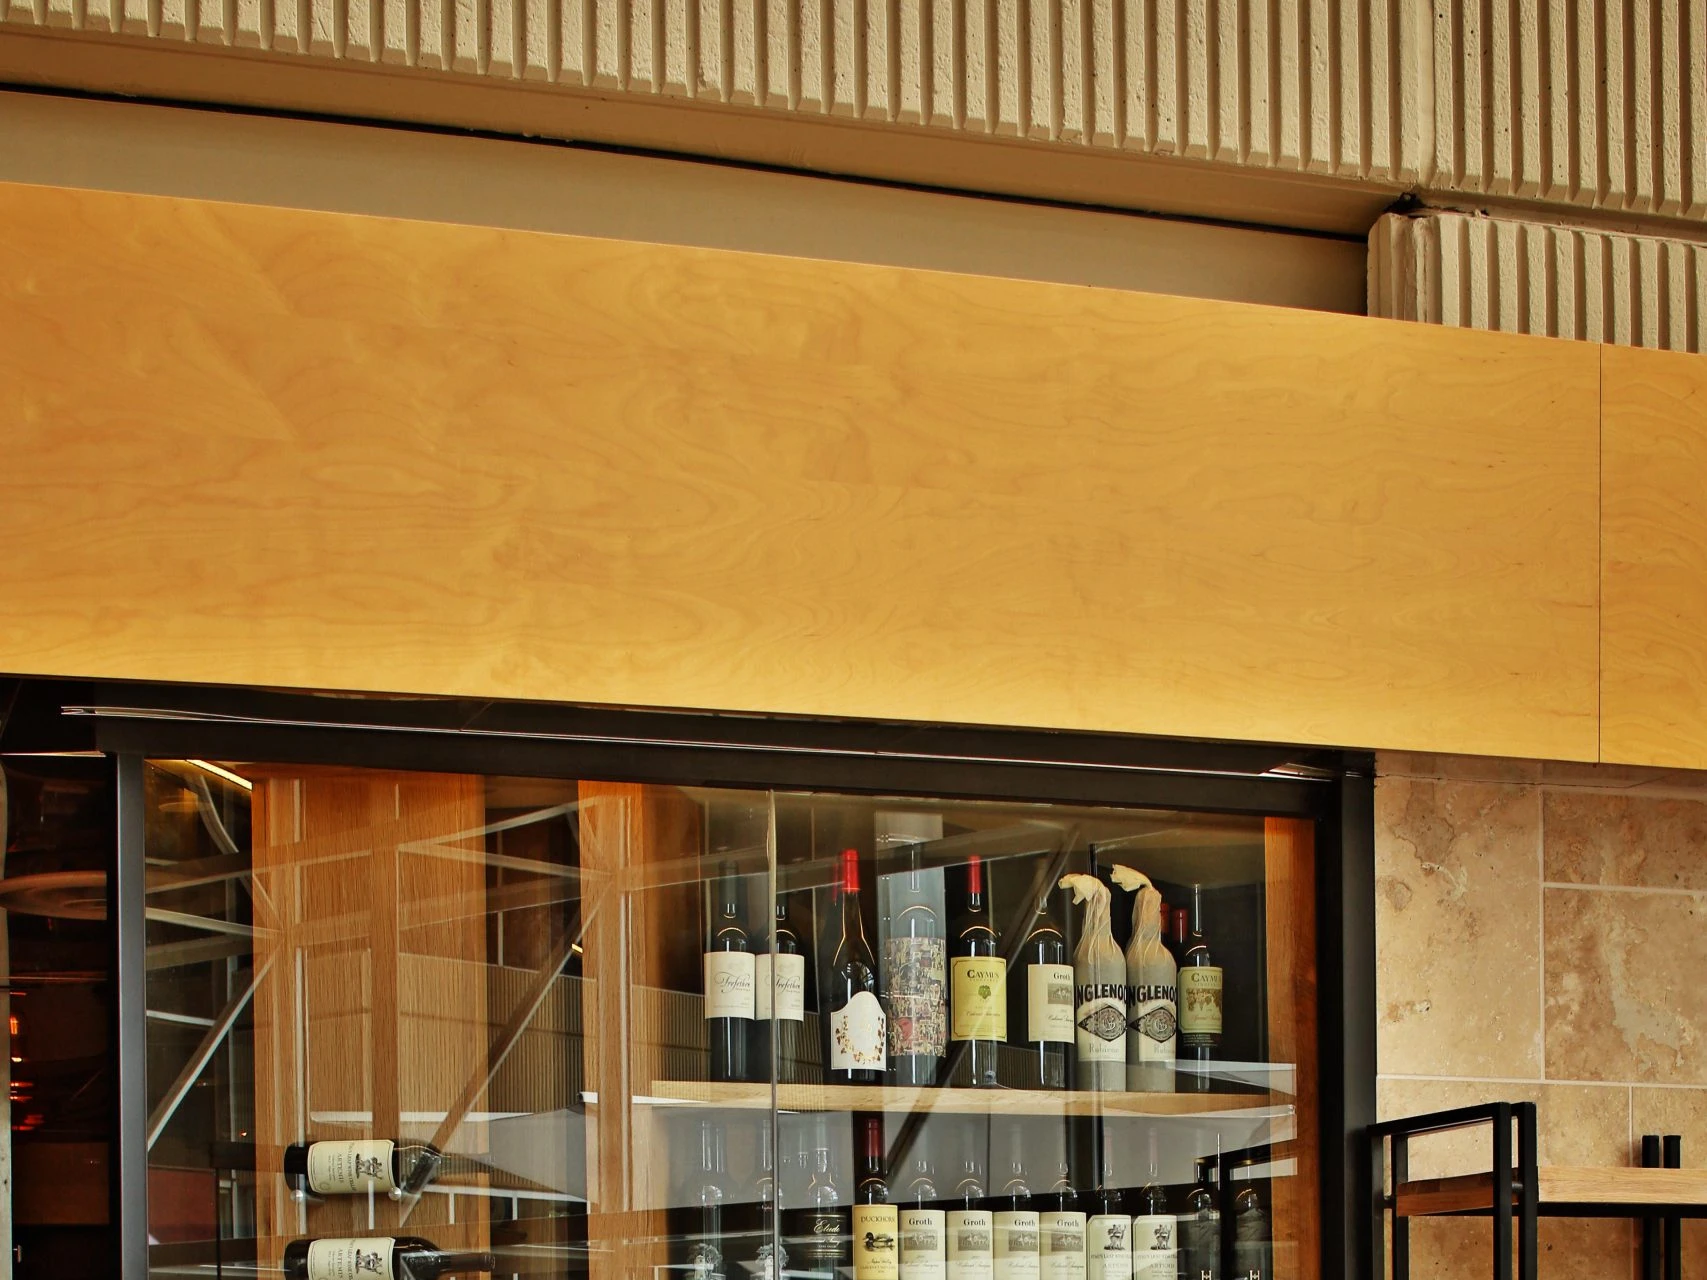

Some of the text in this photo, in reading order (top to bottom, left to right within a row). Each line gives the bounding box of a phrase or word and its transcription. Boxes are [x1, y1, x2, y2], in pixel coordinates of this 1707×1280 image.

[909, 1218, 933, 1226] Groth
[1014, 1219, 1036, 1227] Groth
[1057, 1219, 1080, 1228] Groth
